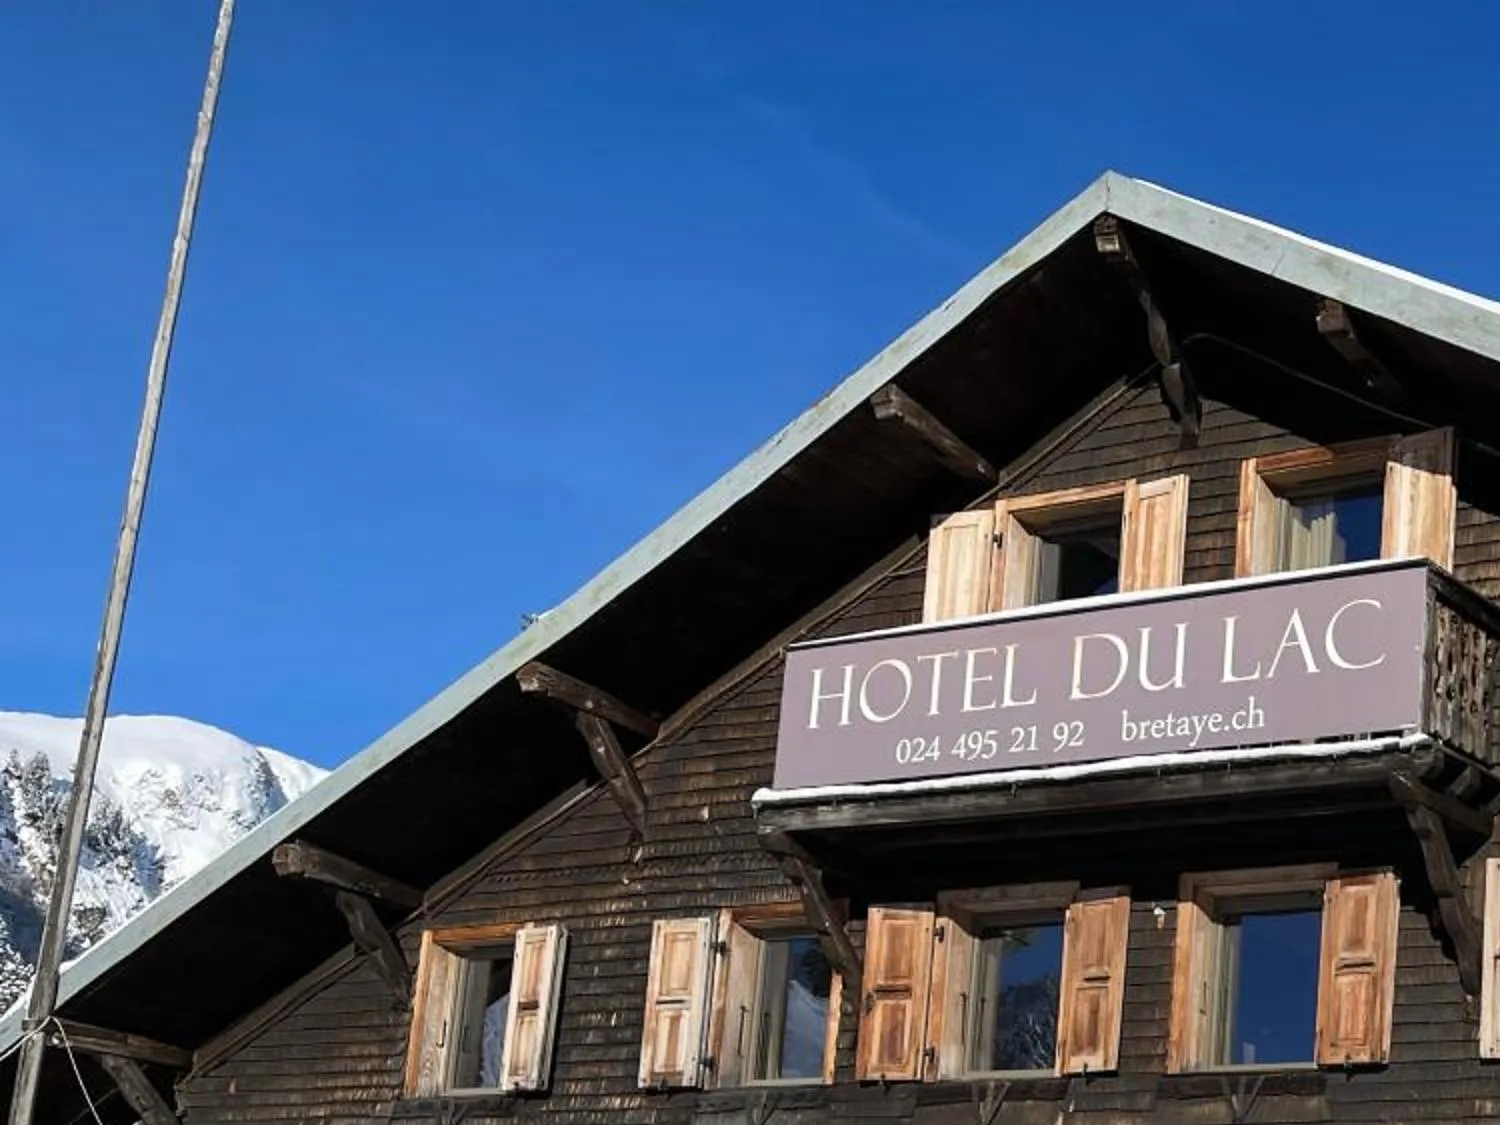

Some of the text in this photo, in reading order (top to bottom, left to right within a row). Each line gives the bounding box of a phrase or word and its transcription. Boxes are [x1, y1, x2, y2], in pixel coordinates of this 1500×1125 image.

[807, 599, 1387, 729] HOTEL DU LAC
[896, 698, 1265, 765] 024 495 21 92 bretaye.ch
